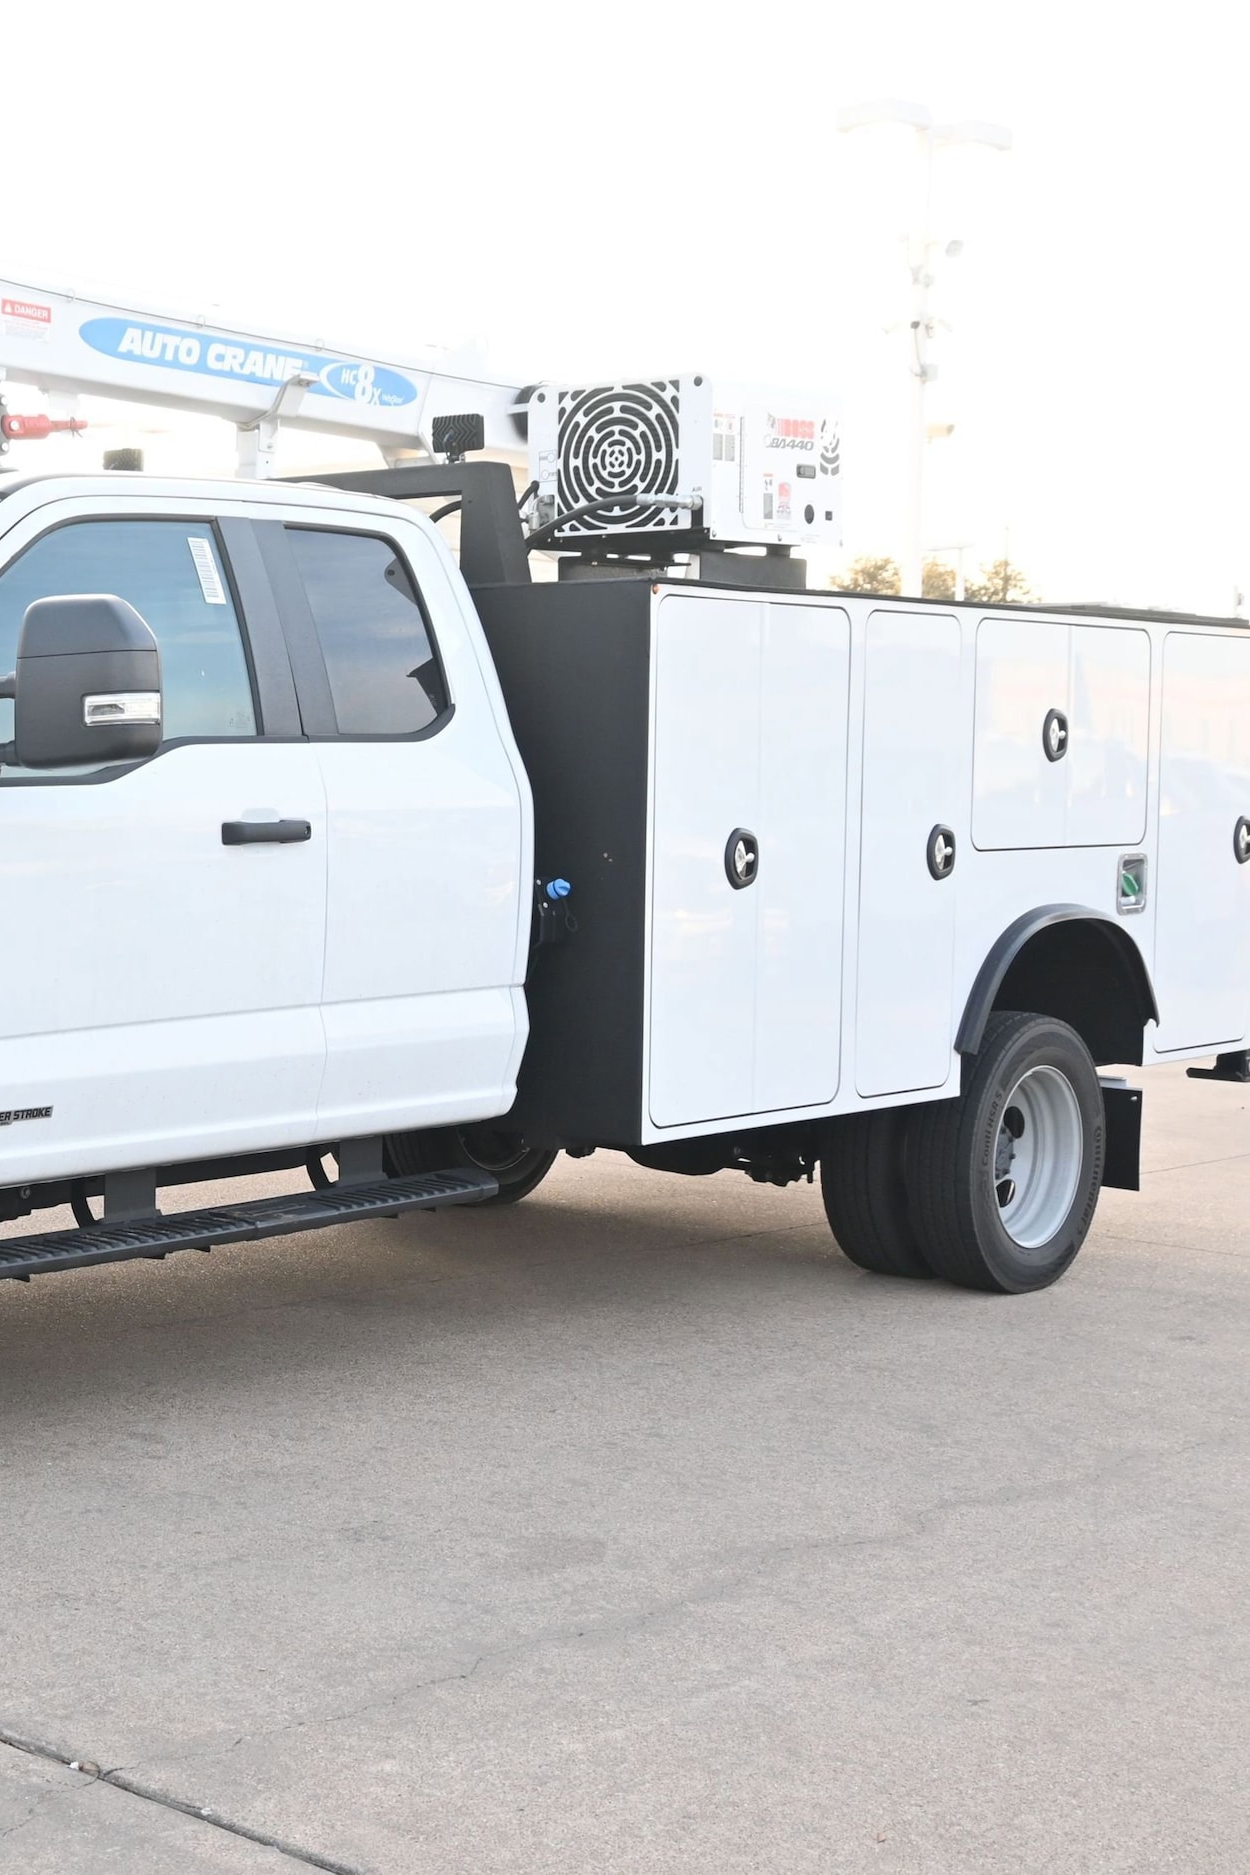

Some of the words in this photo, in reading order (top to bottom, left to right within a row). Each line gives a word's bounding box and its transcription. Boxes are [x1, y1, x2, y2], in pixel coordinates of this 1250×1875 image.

[14, 304, 48, 319] DANGER
[118, 327, 201, 366] AUTO
[13, 1106, 53, 1120] STROKE
